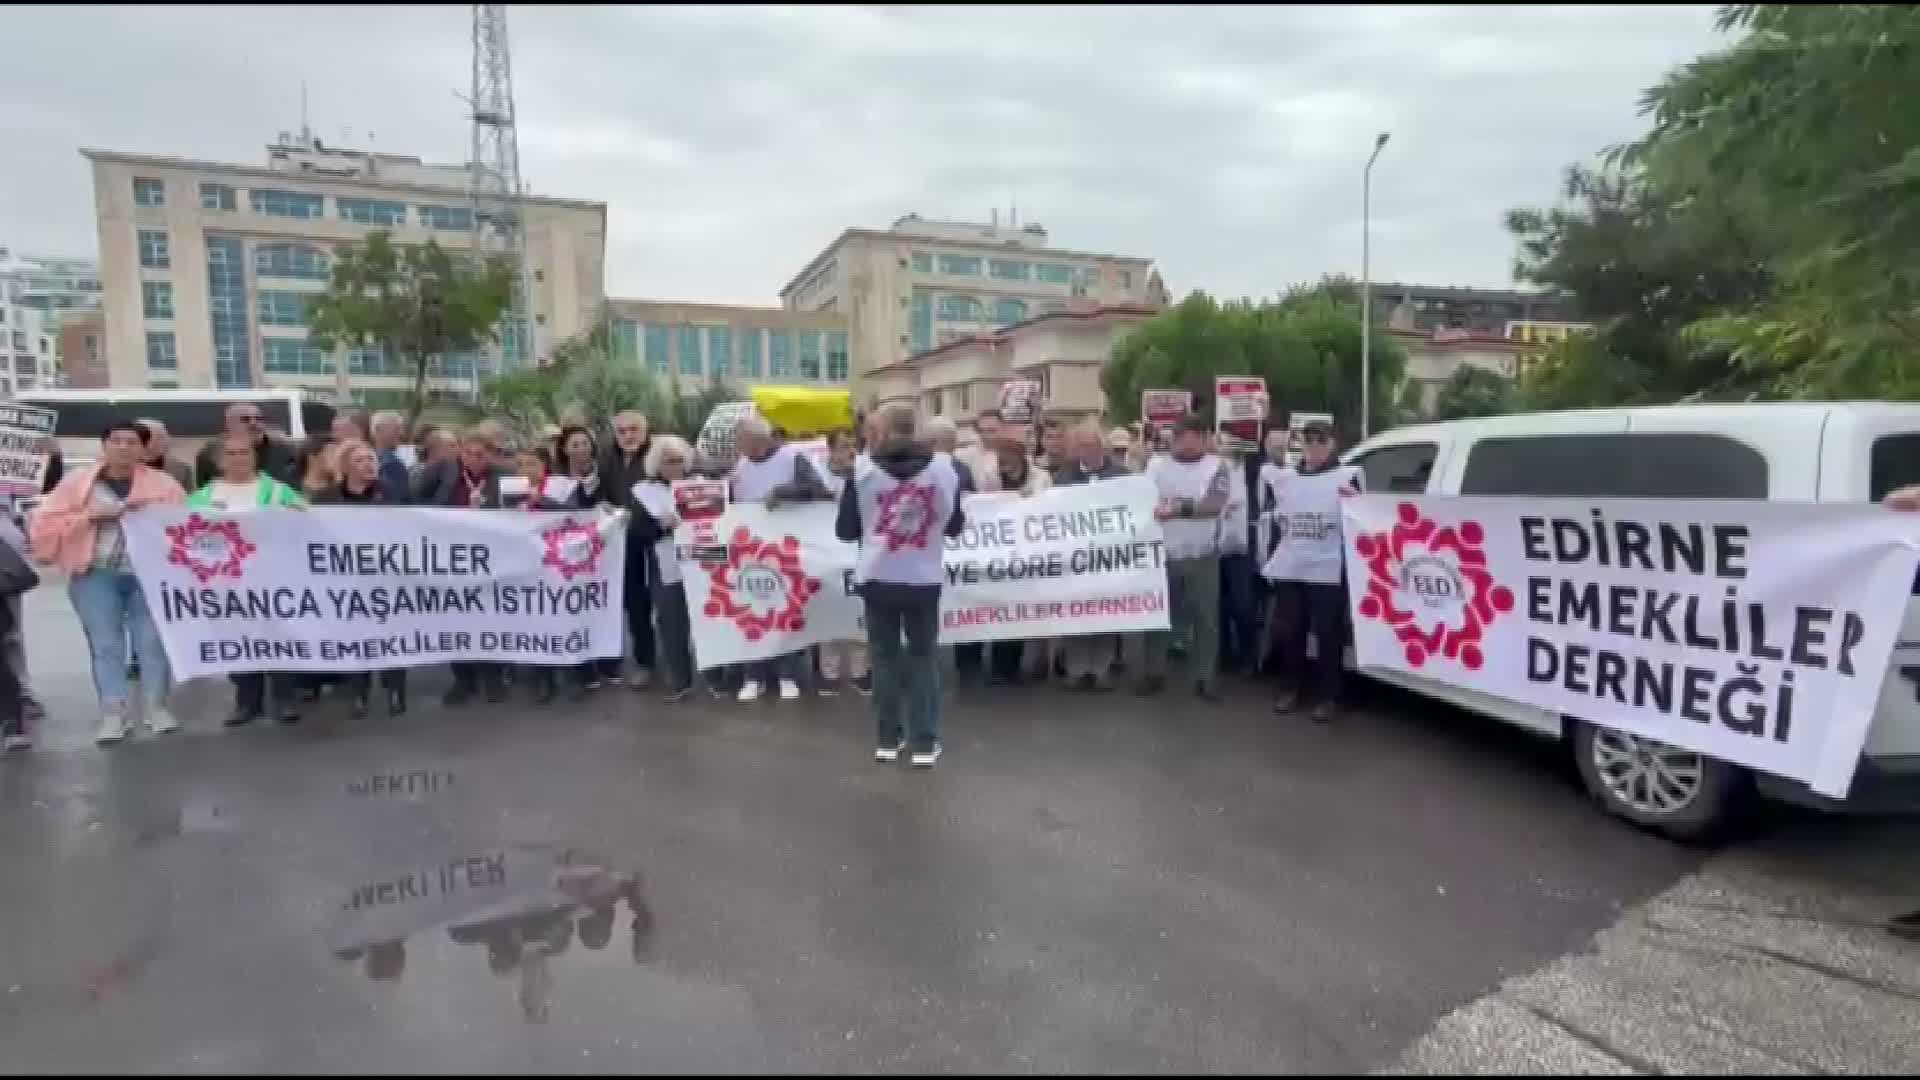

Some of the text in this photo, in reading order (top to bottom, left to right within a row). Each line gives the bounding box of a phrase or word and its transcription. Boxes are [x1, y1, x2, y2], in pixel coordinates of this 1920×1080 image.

[307, 536, 490, 575] EMEKLİLER
[1520, 507, 1750, 579] EDİRNE
[987, 550, 1062, 583] GÖRE
[161, 581, 322, 623] İNSANCA
[328, 583, 486, 625] YAŞAMAK
[1070, 590, 1164, 618] DERNEĞİ
[200, 627, 591, 663] EDİRNE EMEKLİLER DERNEĞİ
[1527, 575, 1865, 677] EMEKLİLER
[1527, 637, 1795, 743] DERNEĞİ
